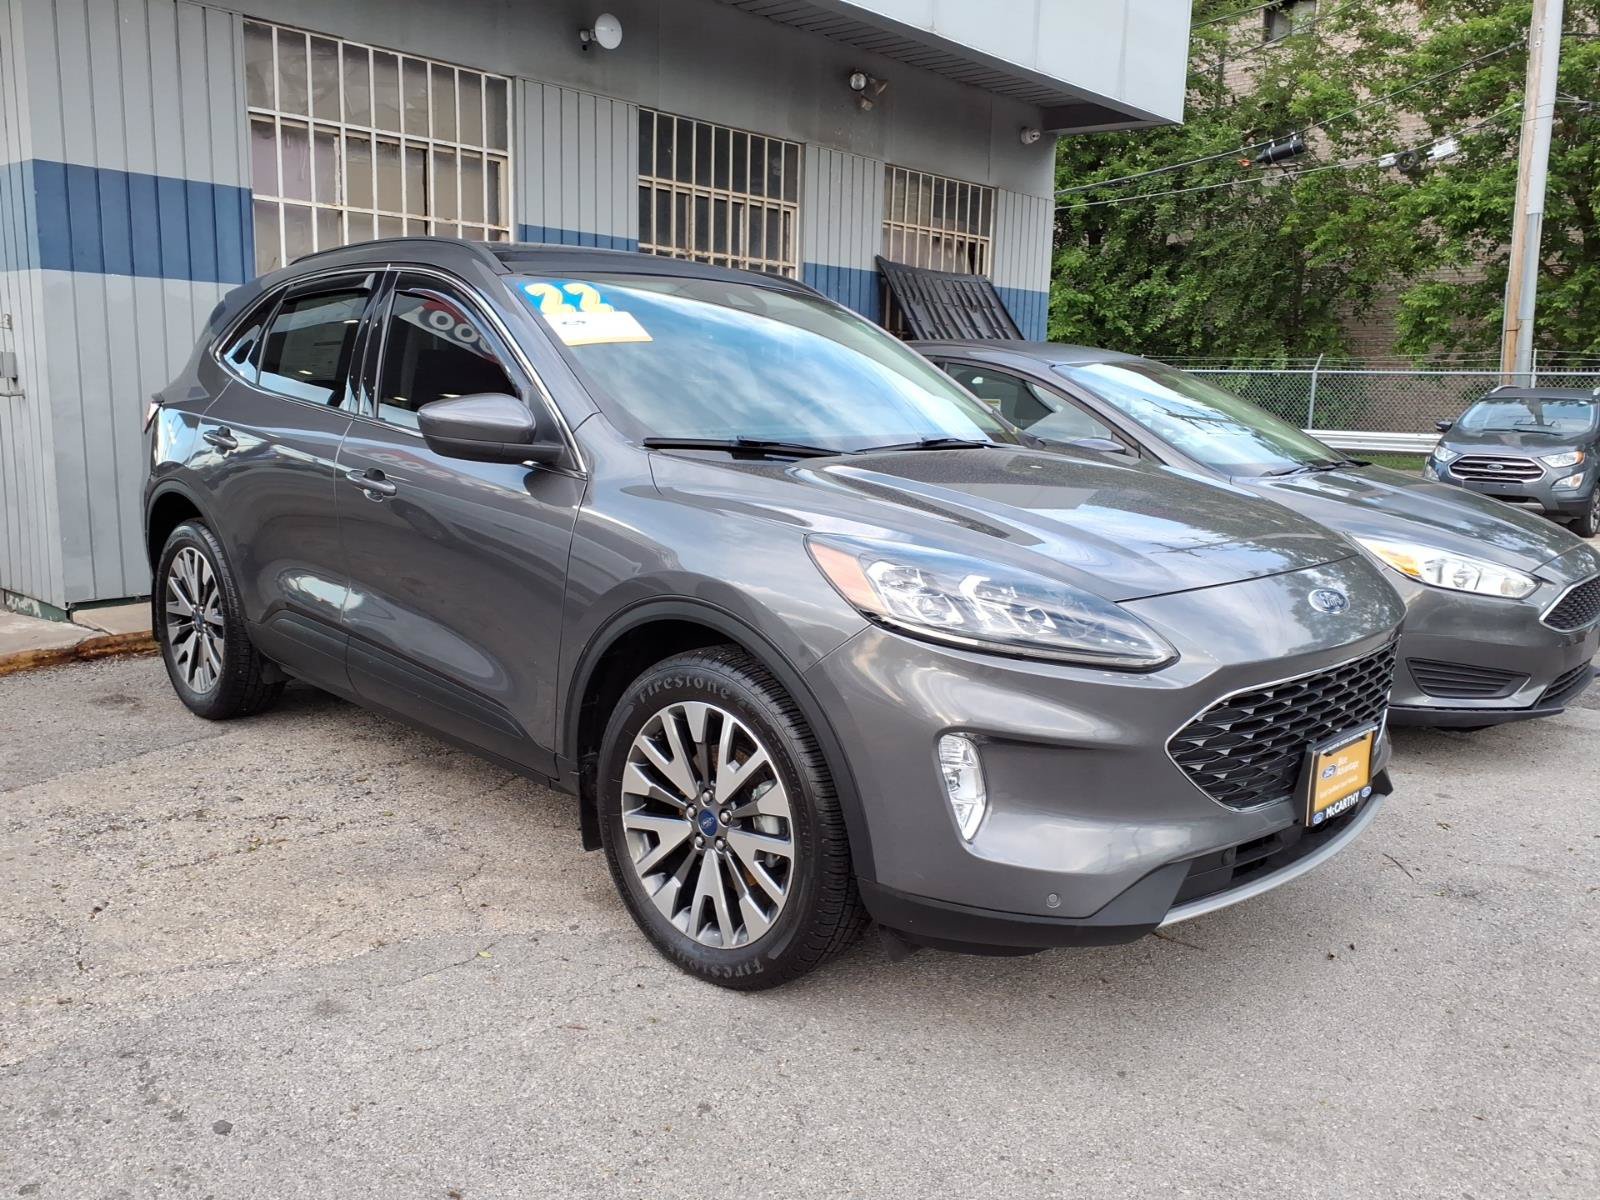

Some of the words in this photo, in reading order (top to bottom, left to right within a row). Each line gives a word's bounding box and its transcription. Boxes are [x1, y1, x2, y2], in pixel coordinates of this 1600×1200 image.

[524, 283, 615, 312] 22
[637, 674, 731, 703] Firestone
[1325, 791, 1360, 818] McCARTHY
